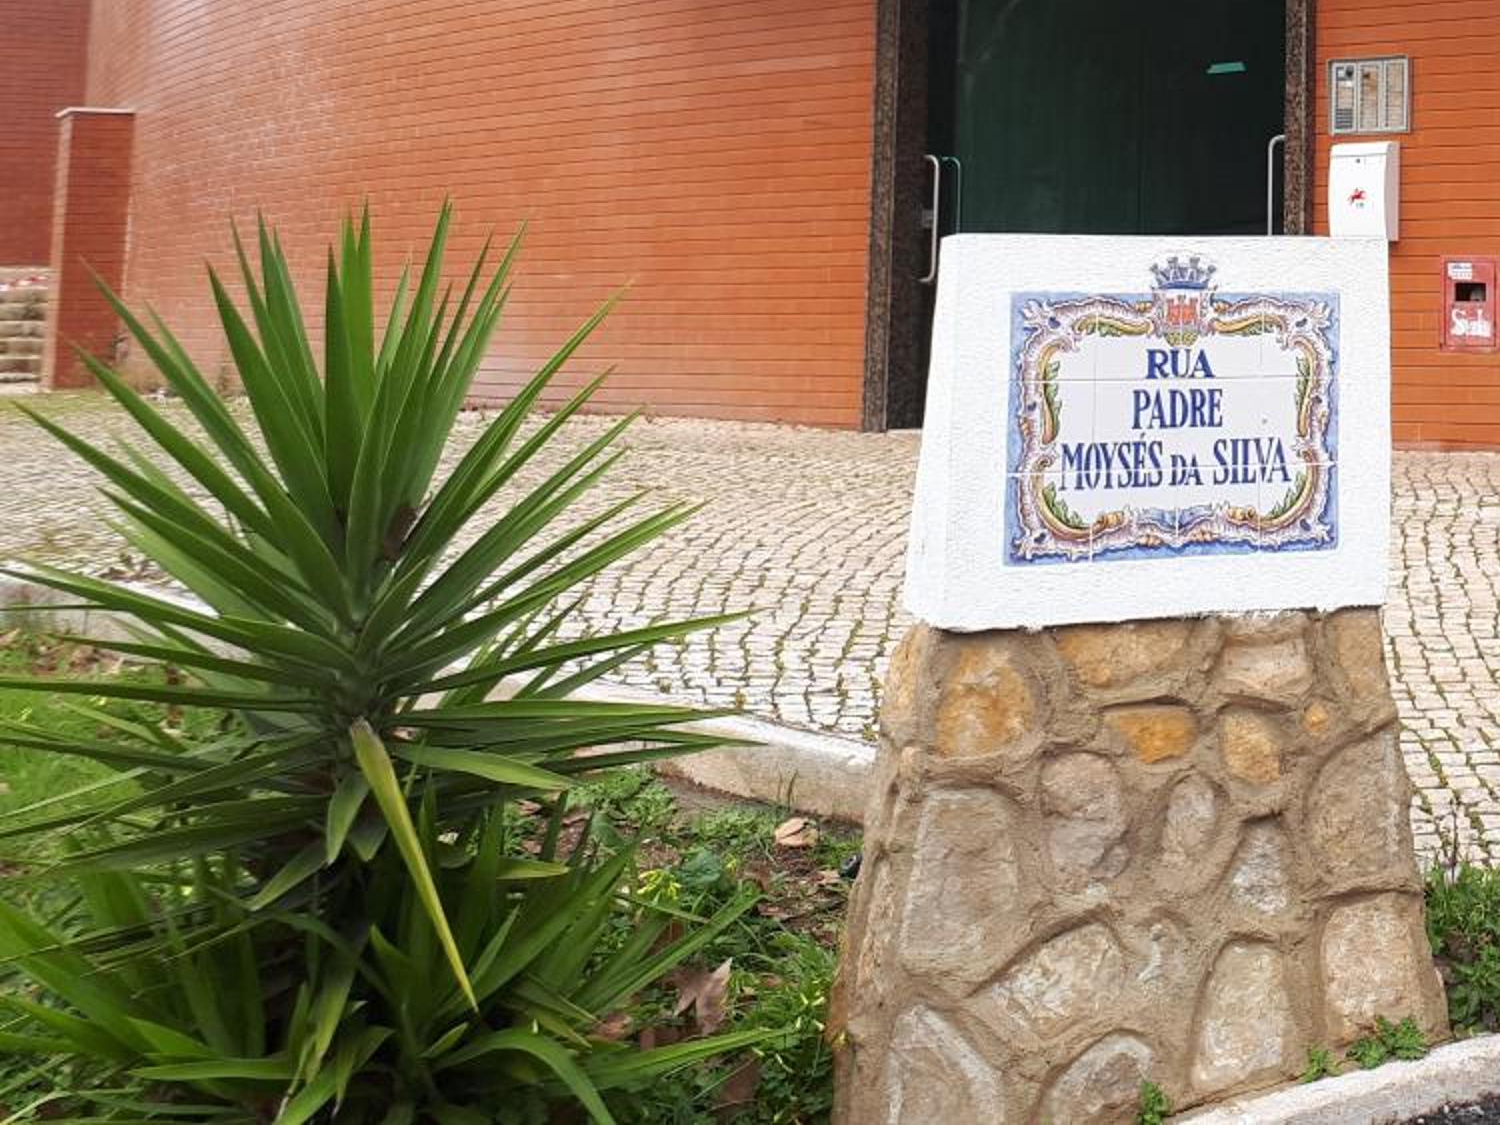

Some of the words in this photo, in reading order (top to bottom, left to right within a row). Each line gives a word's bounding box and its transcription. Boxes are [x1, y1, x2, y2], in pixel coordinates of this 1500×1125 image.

[1146, 348, 1215, 380] RUA
[1131, 388, 1224, 430] PADRE
[1058, 431, 1164, 491] MOYSÉS
[1168, 454, 1204, 487] DA
[1212, 436, 1292, 486] SILVA
